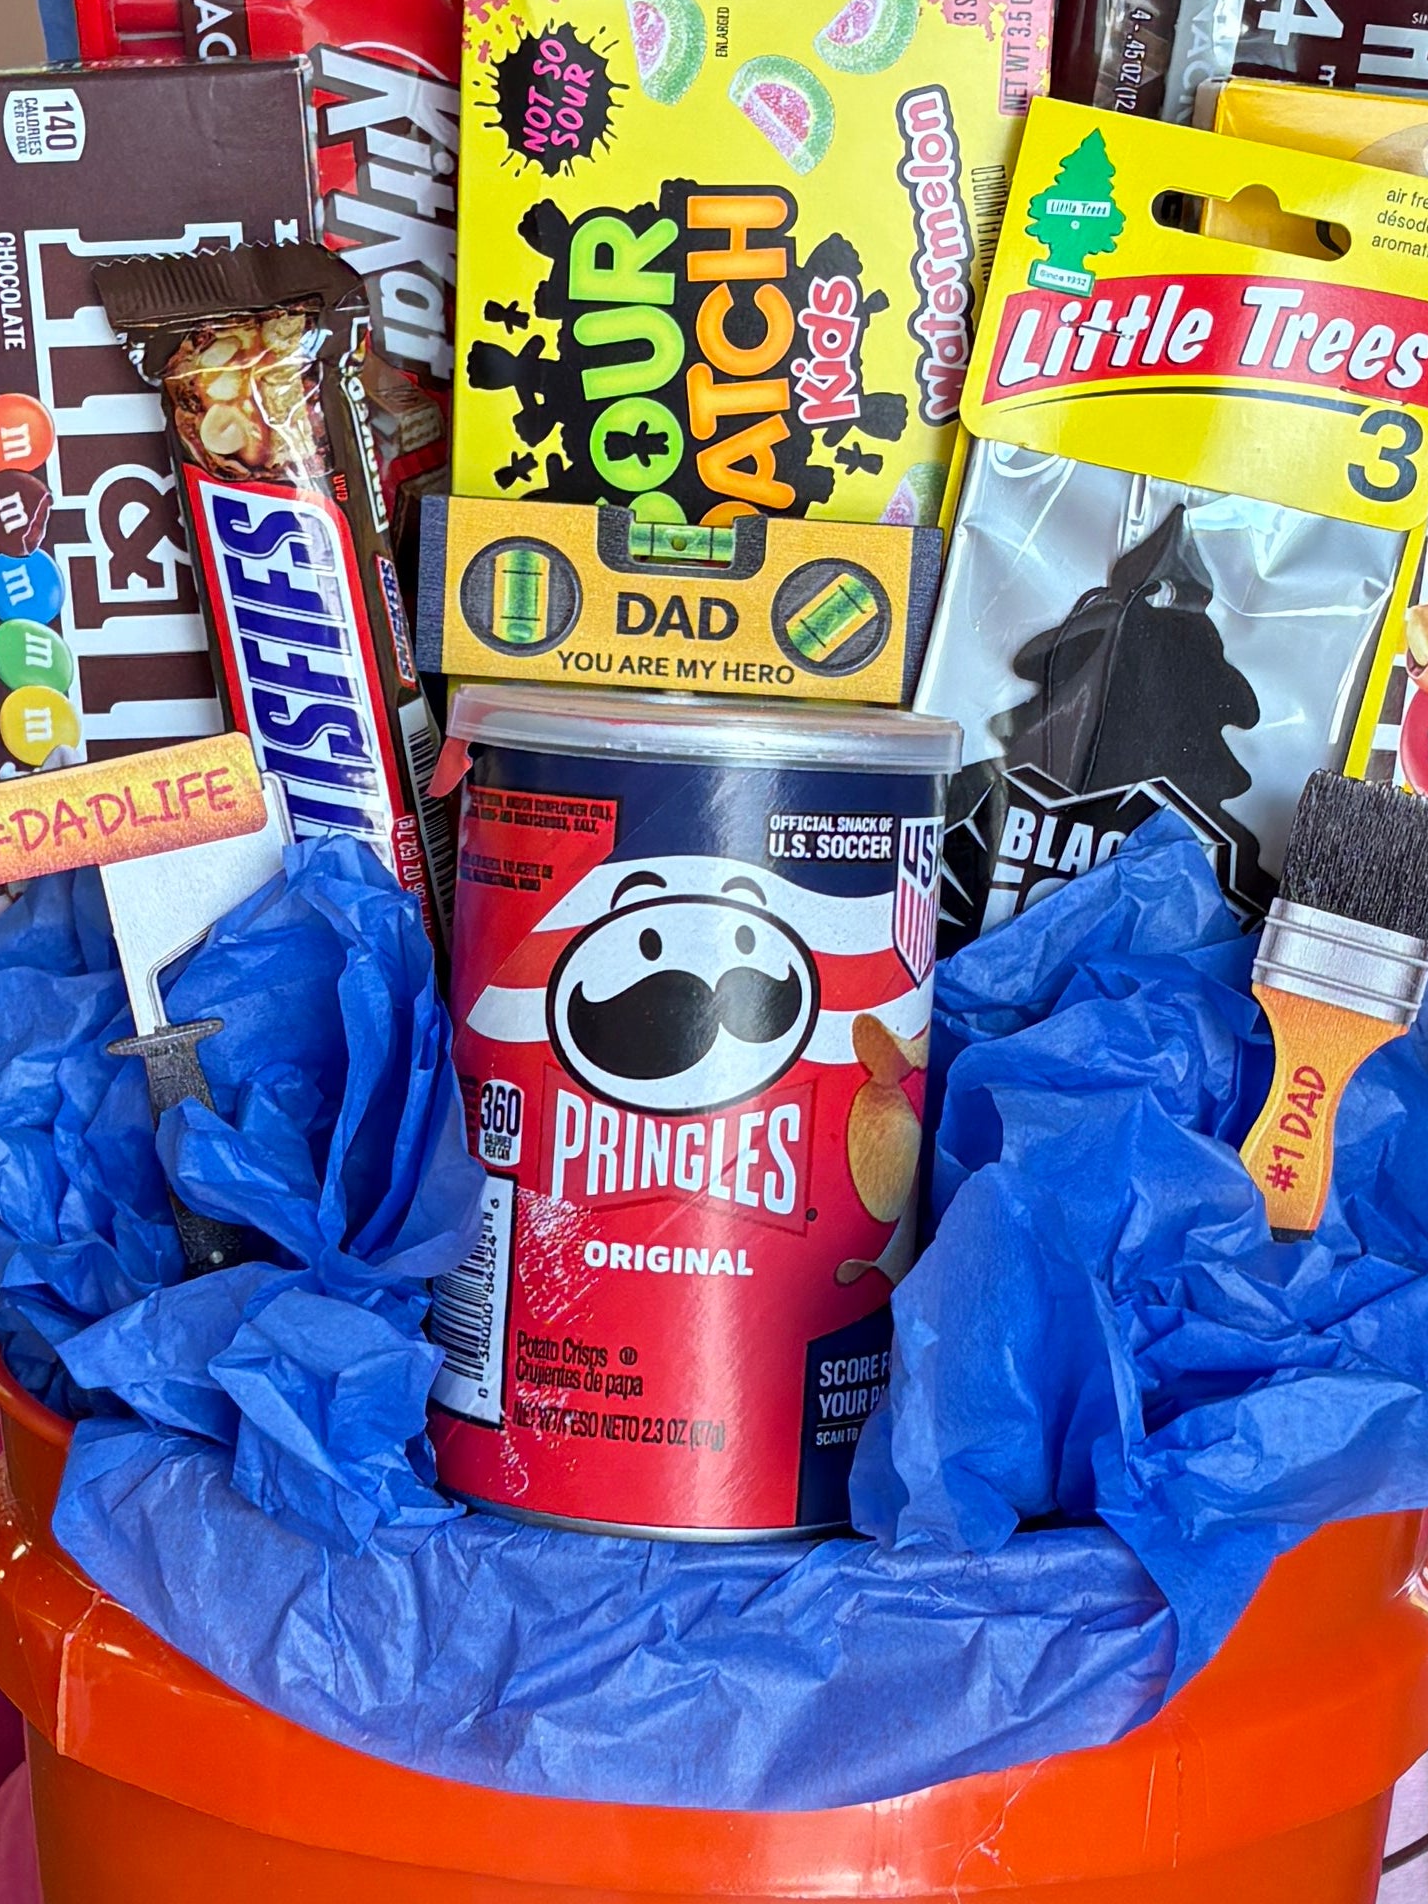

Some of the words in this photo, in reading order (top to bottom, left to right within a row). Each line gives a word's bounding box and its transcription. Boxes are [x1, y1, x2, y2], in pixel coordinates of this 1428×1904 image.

[716, 6, 730, 58] ENLARGED
[954, 10, 977, 24] 3
[1007, 10, 1033, 37] 3.5
[533, 39, 567, 80] SO
[1006, 38, 1030, 70] WT
[551, 63, 594, 148] SOUR
[1003, 76, 1027, 112] NET
[25, 97, 42, 156] CALORIES
[43, 101, 77, 150] 140
[523, 86, 554, 152] NOT
[1387, 188, 1408, 204] air
[796, 276, 861, 424] Kids
[998, 284, 1214, 388] Little
[569, 214, 687, 524] OUR
[687, 195, 798, 524] ATCH
[1348, 409, 1424, 503] 3
[616, 592, 740, 641] DAD
[557, 650, 613, 675] YOU
[618, 655, 669, 677] ARE
[676, 658, 716, 680] MY
[723, 661, 795, 685] HERO
[768, 833, 812, 859] U.S.
[816, 836, 892, 860] SOCCER
[770, 815, 833, 834] OFFICIAL
[836, 816, 879, 834] SNACK
[879, 817, 894, 833] OF
[480, 1082, 521, 1137] 360
[1278, 1065, 1326, 1139] DAD
[552, 1089, 801, 1215] PRINGLES
[1265, 1146, 1305, 1193] #1
[584, 1241, 754, 1276] ORIGINAL
[517, 1330, 559, 1361] Potato
[562, 1337, 608, 1370] Crisps
[819, 1354, 879, 1387] SCORE
[515, 1355, 581, 1390] Crujientes
[584, 1368, 603, 1392] de
[605, 1374, 643, 1400] papa
[819, 1388, 868, 1419] YOUR
[601, 1413, 640, 1442] NETO
[641, 1416, 664, 1445] 2.3
[667, 1418, 689, 1446] OZ
[816, 1429, 844, 1446] SCAN
